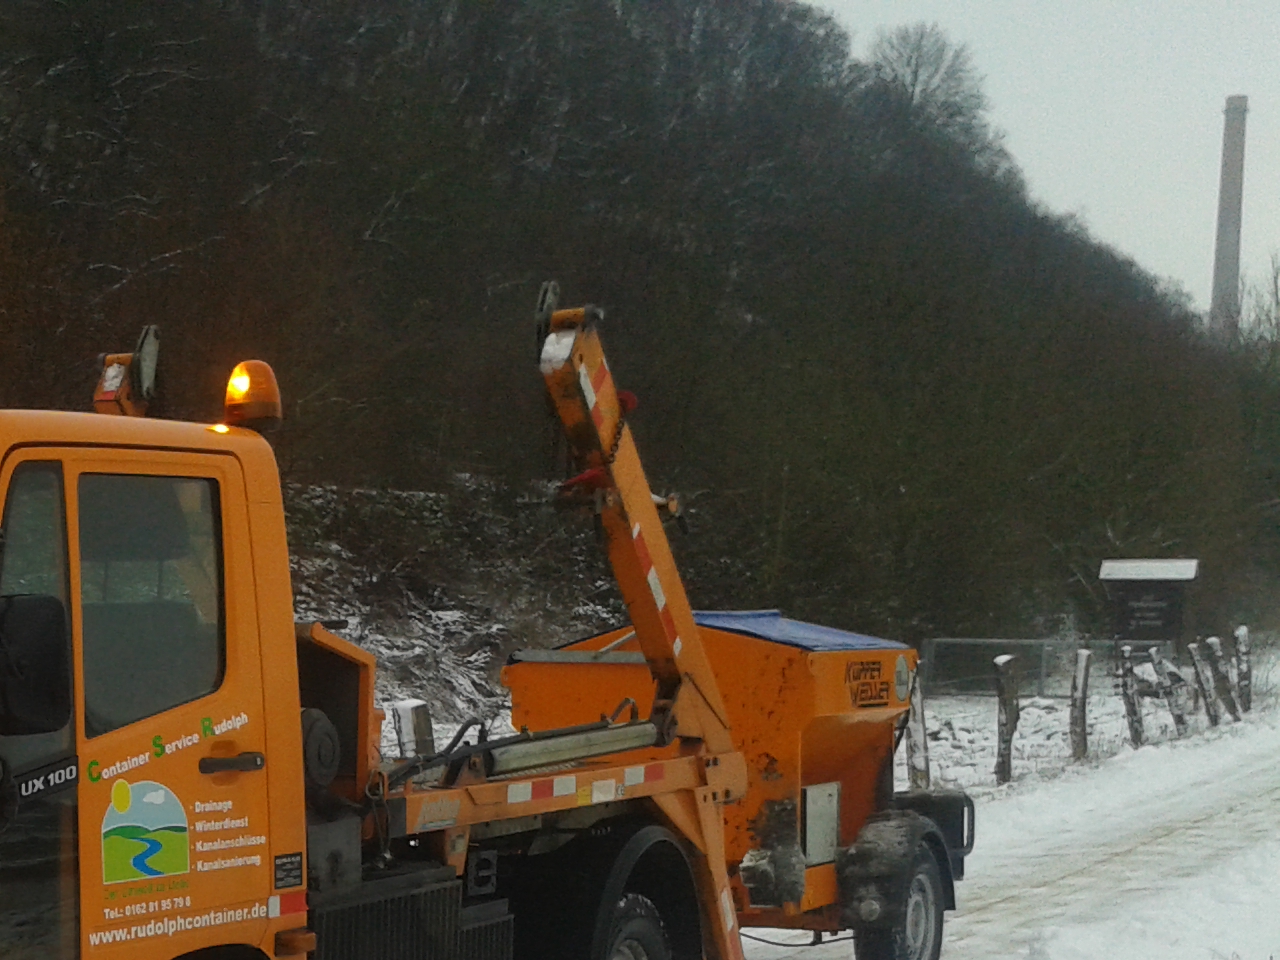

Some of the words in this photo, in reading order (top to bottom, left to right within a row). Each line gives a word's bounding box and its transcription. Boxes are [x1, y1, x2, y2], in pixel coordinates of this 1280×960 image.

[87, 751, 150, 783] Container
[152, 732, 200, 758] Service
[200, 712, 249, 738] Rudolph
[21, 776, 45, 796] UX
[47, 765, 77, 787] 100
[195, 800, 233, 813] Drainage
[195, 816, 248, 833] Winterdienst
[195, 835, 266, 851] Kanalanschlüsse
[197, 855, 261, 872] Kanalsanierung
[125, 903, 147, 917] 0162
[89, 904, 268, 947] www.rudolphcontainer.de
